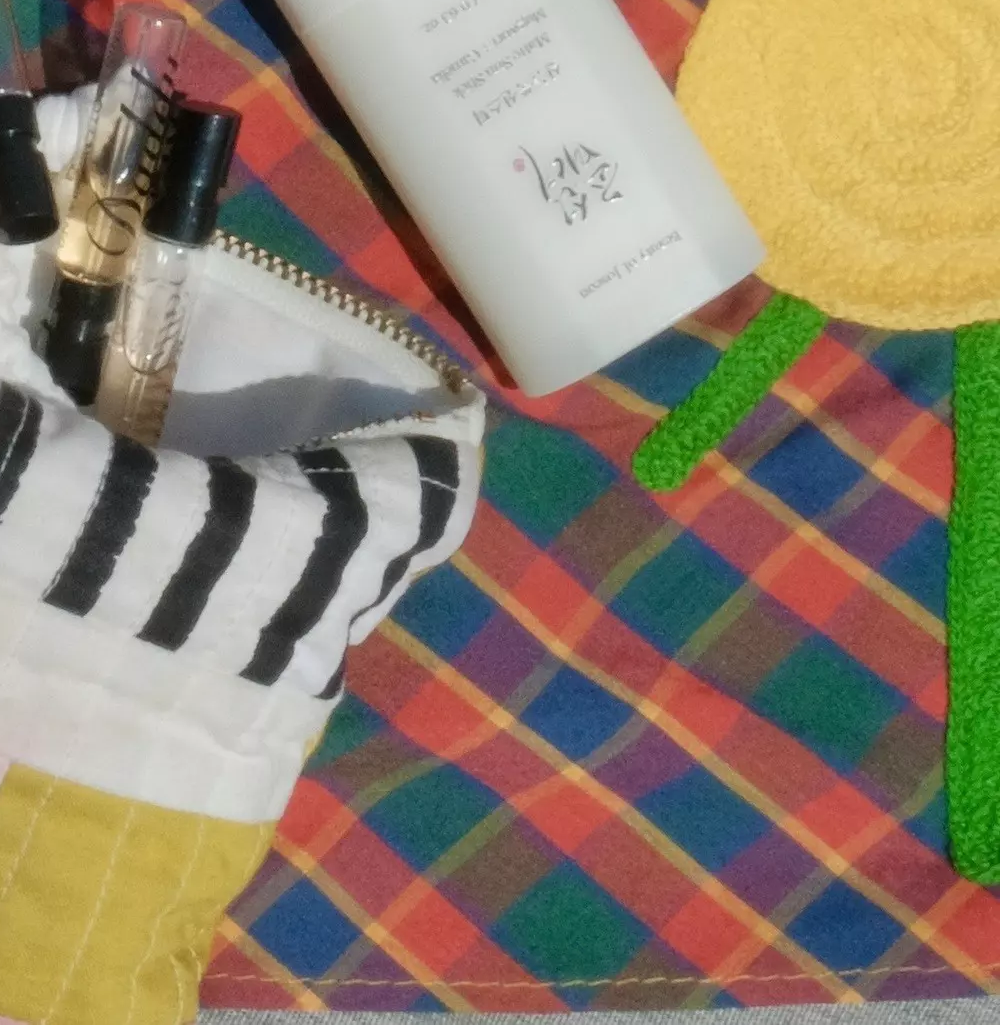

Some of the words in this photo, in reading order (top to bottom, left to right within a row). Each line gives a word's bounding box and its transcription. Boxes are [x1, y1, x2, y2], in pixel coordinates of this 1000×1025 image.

[483, 54, 514, 80] Sun
[450, 70, 488, 98] Stick
[637, 228, 682, 263] Beauty
